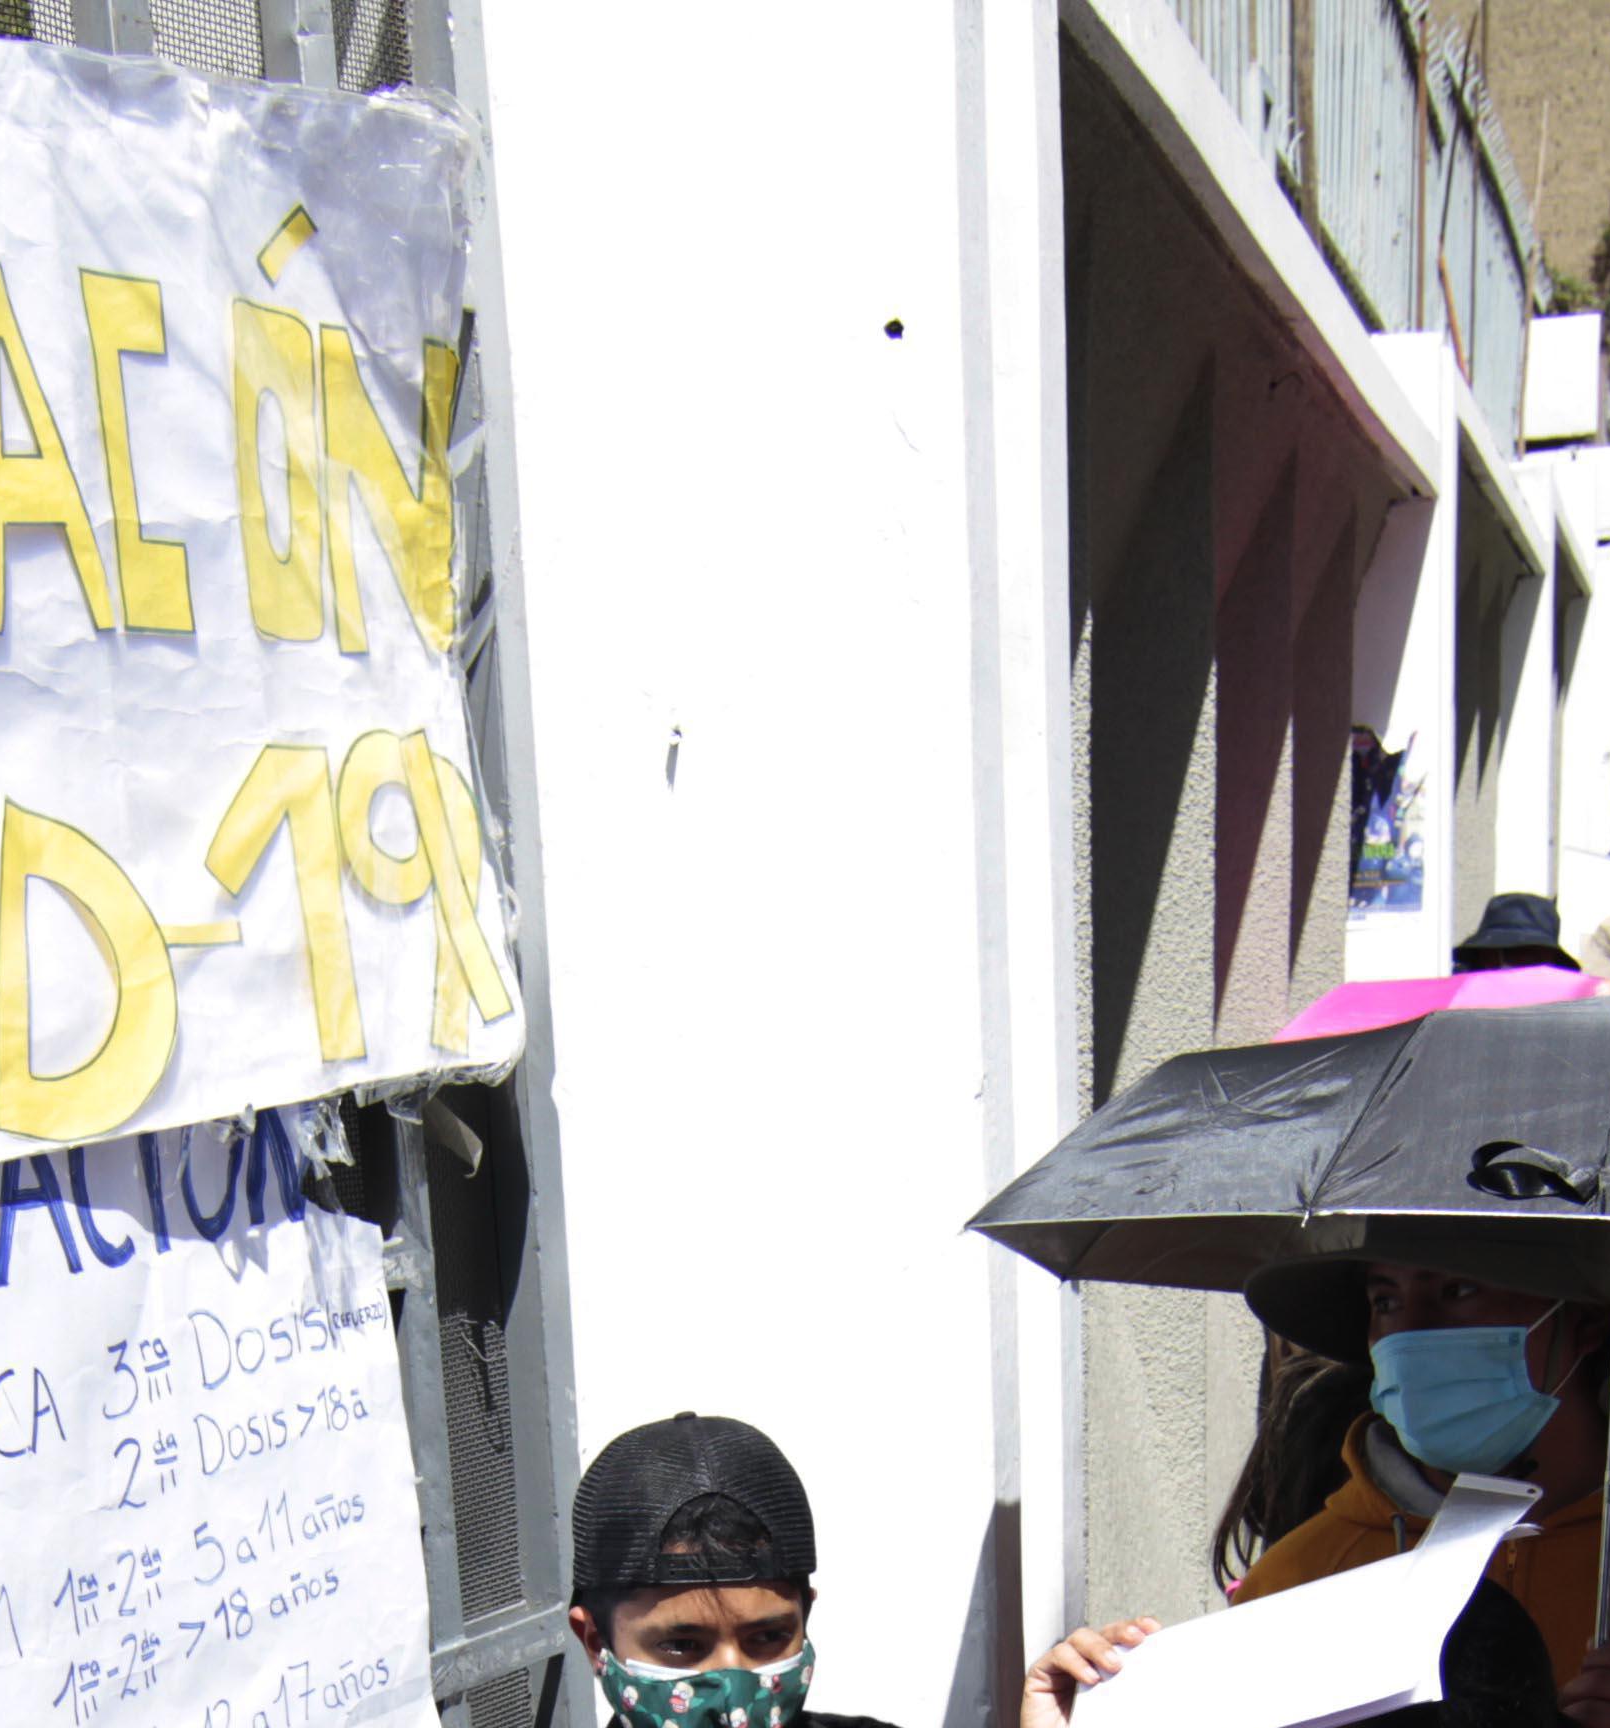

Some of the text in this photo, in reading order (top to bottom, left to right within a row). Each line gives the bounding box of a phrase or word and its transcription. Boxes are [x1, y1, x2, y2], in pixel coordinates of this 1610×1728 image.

[193, 1521, 226, 1586] 5
[257, 1490, 294, 1547] 11
[301, 1493, 366, 1541] años
[268, 1568, 340, 1619] años
[272, 1660, 317, 1728] 17
[322, 1656, 390, 1711] años
